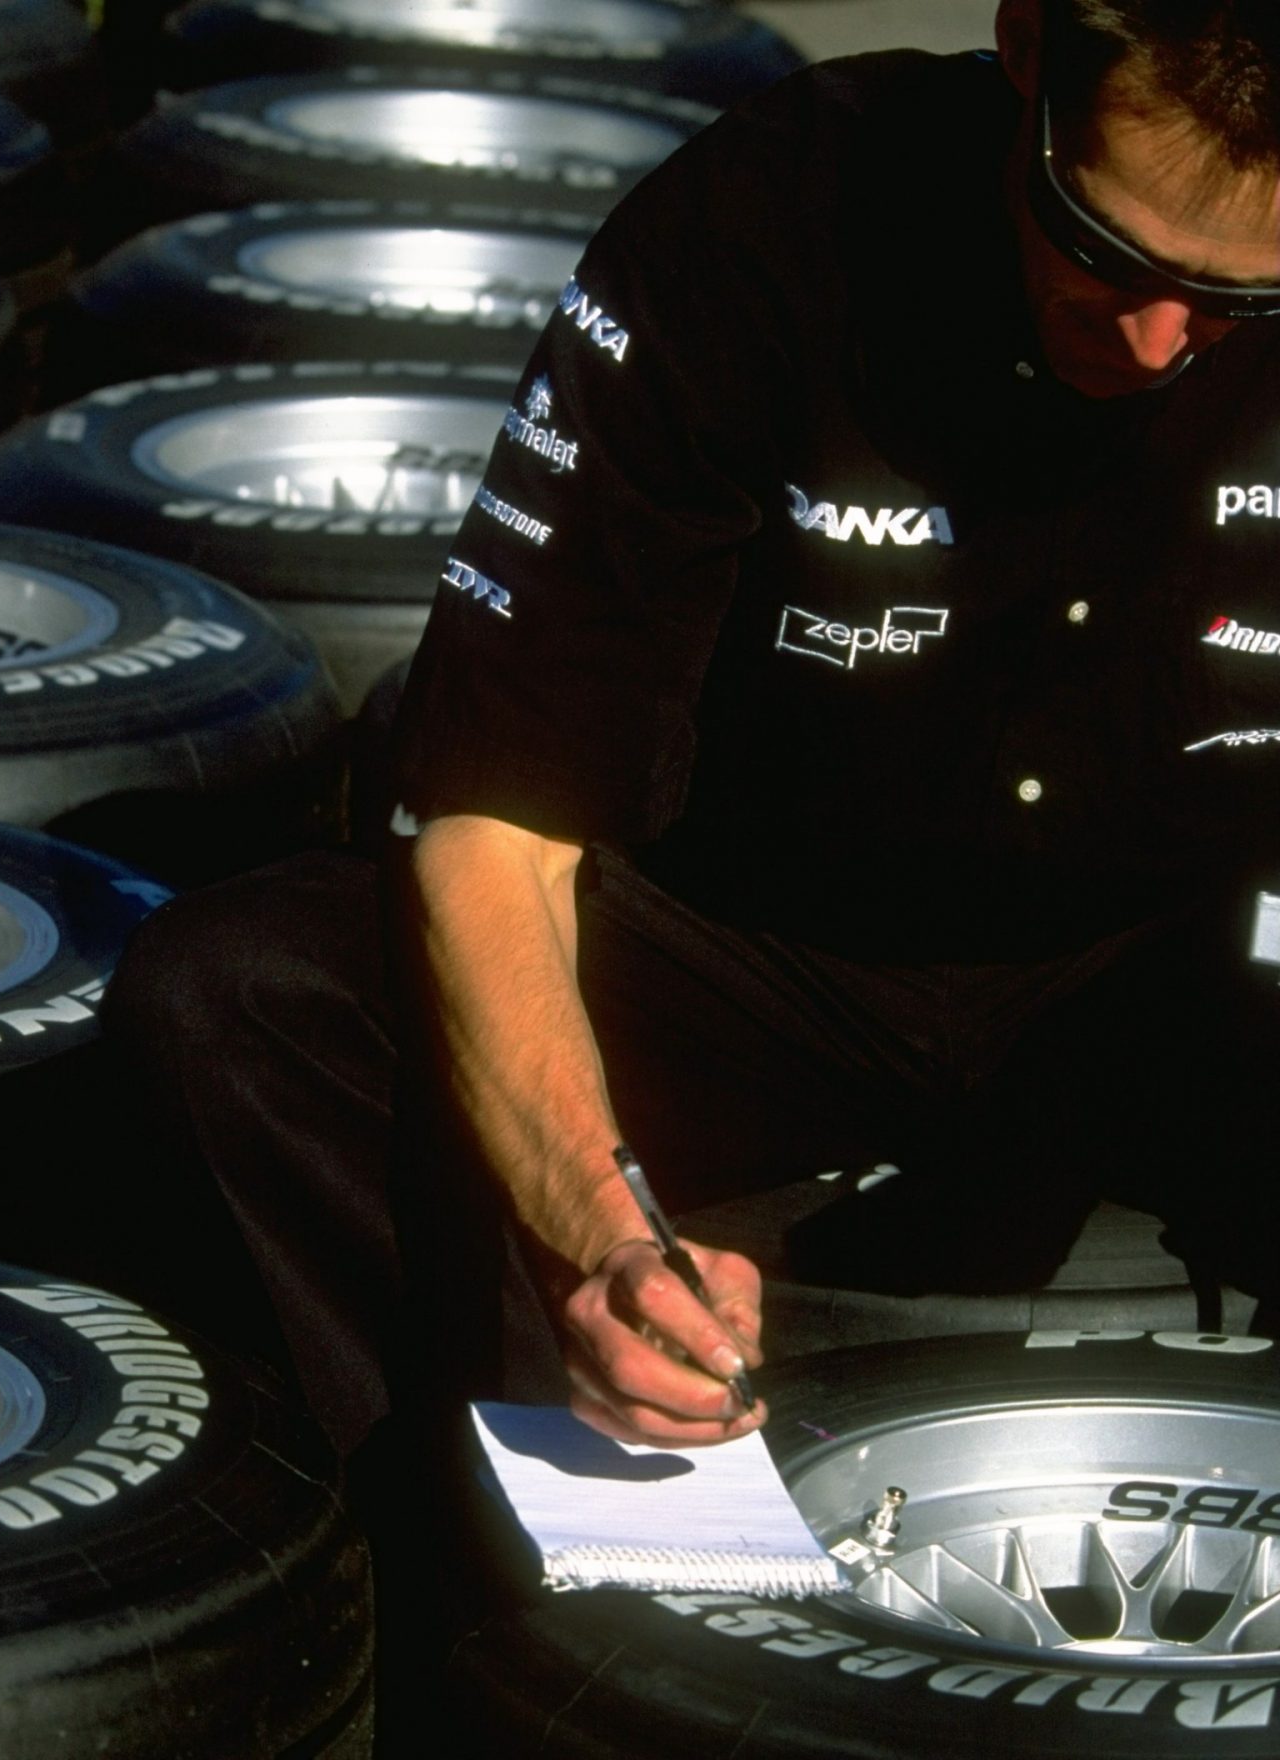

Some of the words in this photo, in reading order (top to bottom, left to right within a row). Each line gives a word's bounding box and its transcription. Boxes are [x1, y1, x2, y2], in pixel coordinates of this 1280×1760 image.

[1216, 485, 1280, 525] pa
[1201, 616, 1280, 654] BRID
[651, 1592, 1280, 1730] BRIDGEST
